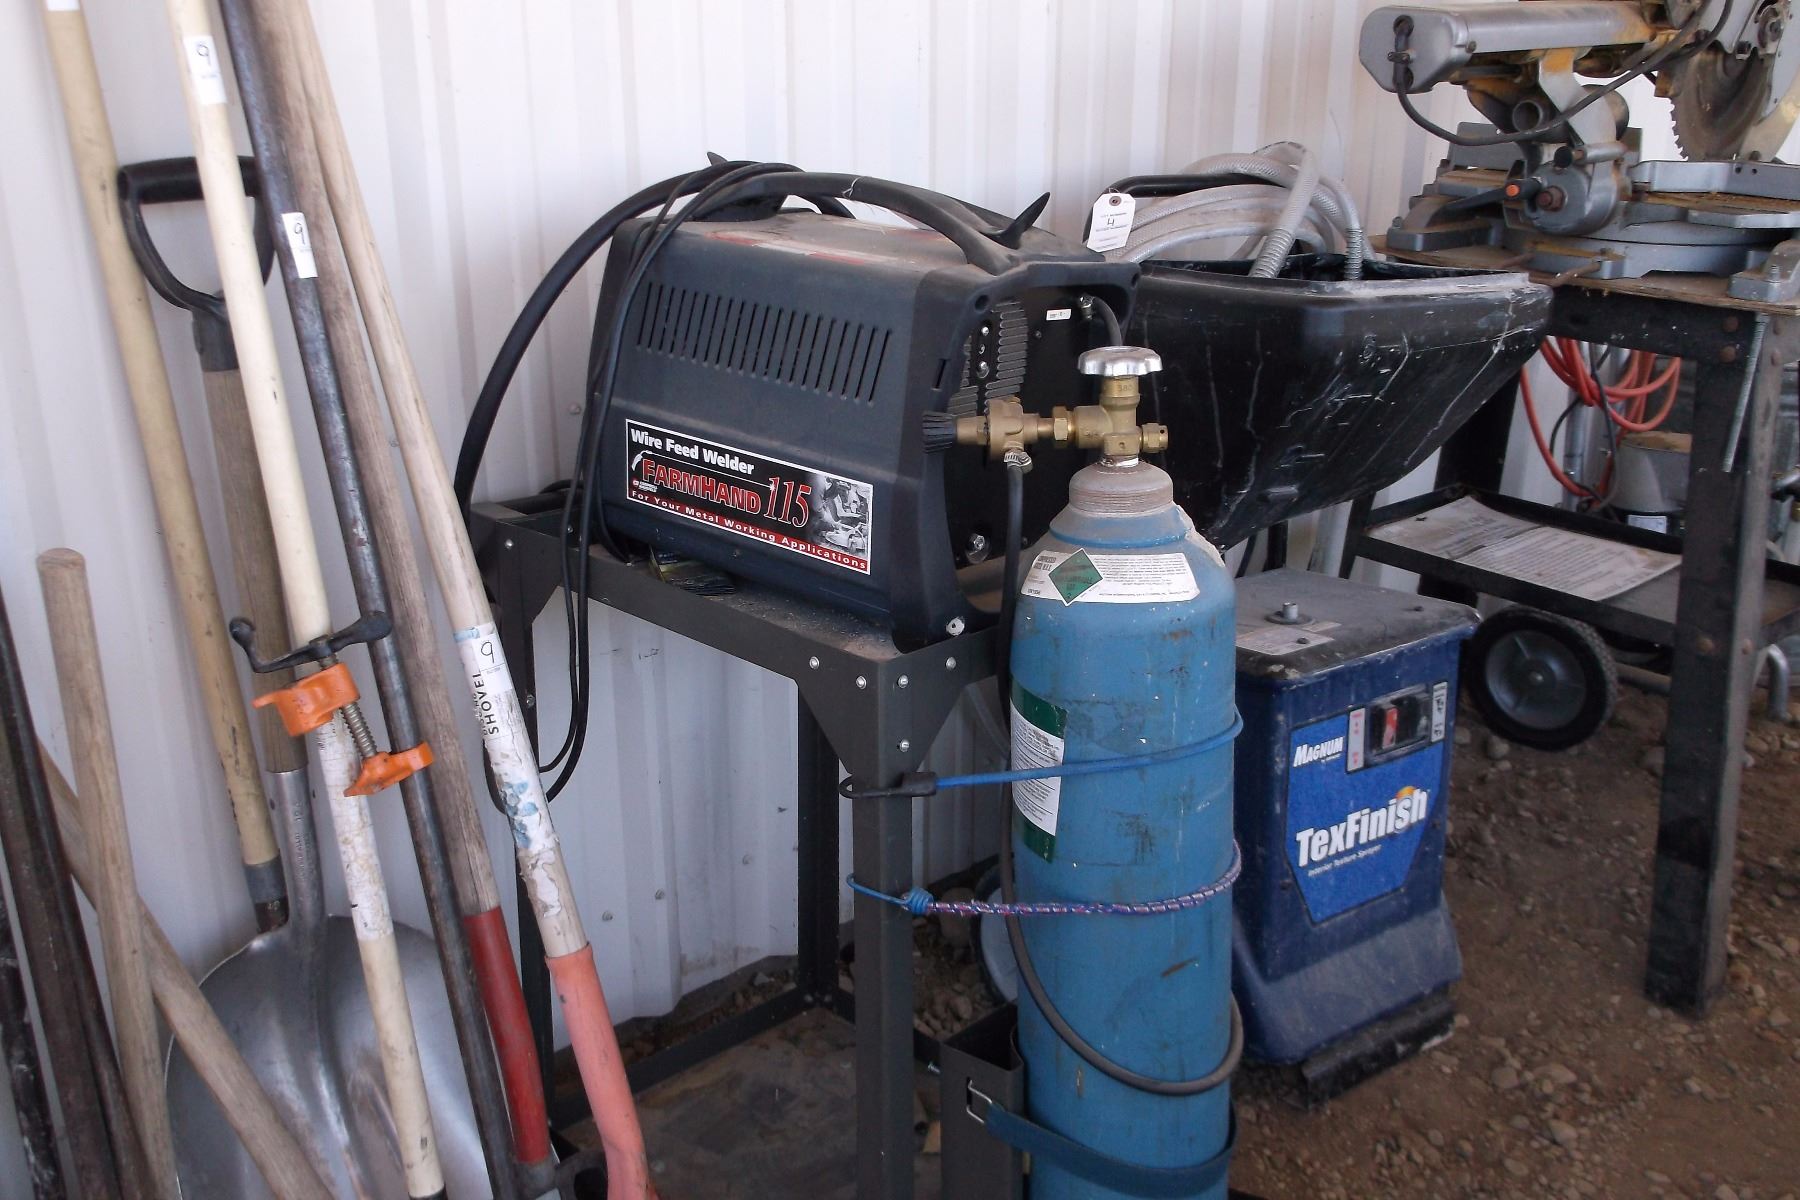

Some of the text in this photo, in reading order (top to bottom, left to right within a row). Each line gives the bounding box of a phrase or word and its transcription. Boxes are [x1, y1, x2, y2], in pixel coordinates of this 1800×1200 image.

[196, 43, 212, 67] 9
[294, 222, 306, 245] 9
[631, 428, 755, 475] Wire Feed Welder
[642, 458, 812, 528] FARMHAND 115
[632, 490, 866, 570] For Your Metal Working Applications
[480, 641, 495, 664] 9
[1295, 788, 1428, 867] TexFinish
